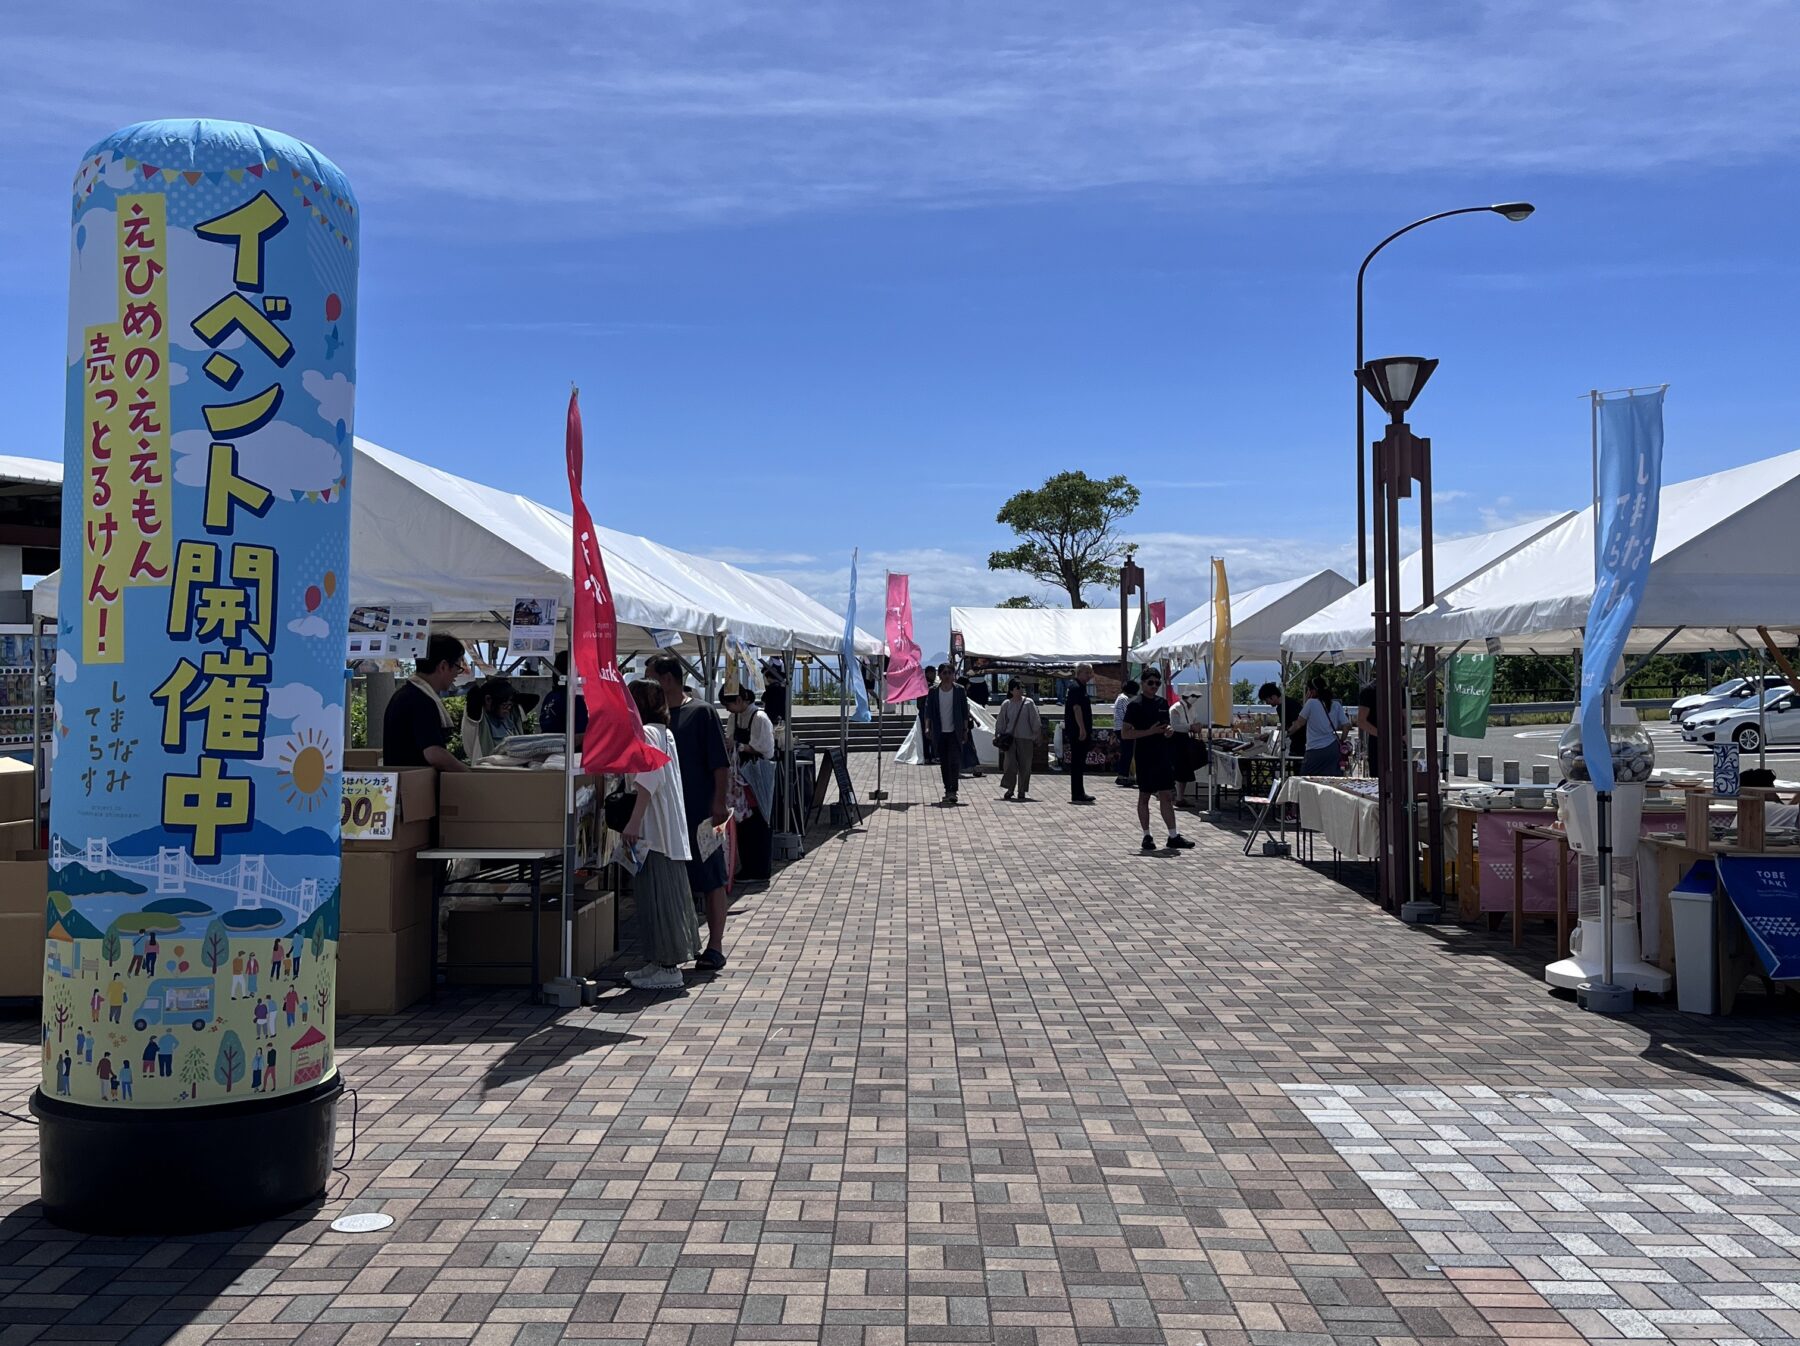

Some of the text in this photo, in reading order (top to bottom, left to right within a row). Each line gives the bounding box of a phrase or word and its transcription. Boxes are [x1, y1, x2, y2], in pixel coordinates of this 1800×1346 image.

[121, 202, 168, 581] えひめのええもん
[151, 190, 296, 864] イベント開催中
[106, 680, 139, 792] しまなみ
[1453, 682, 1486, 697] Market
[81, 708, 103, 798] てらす
